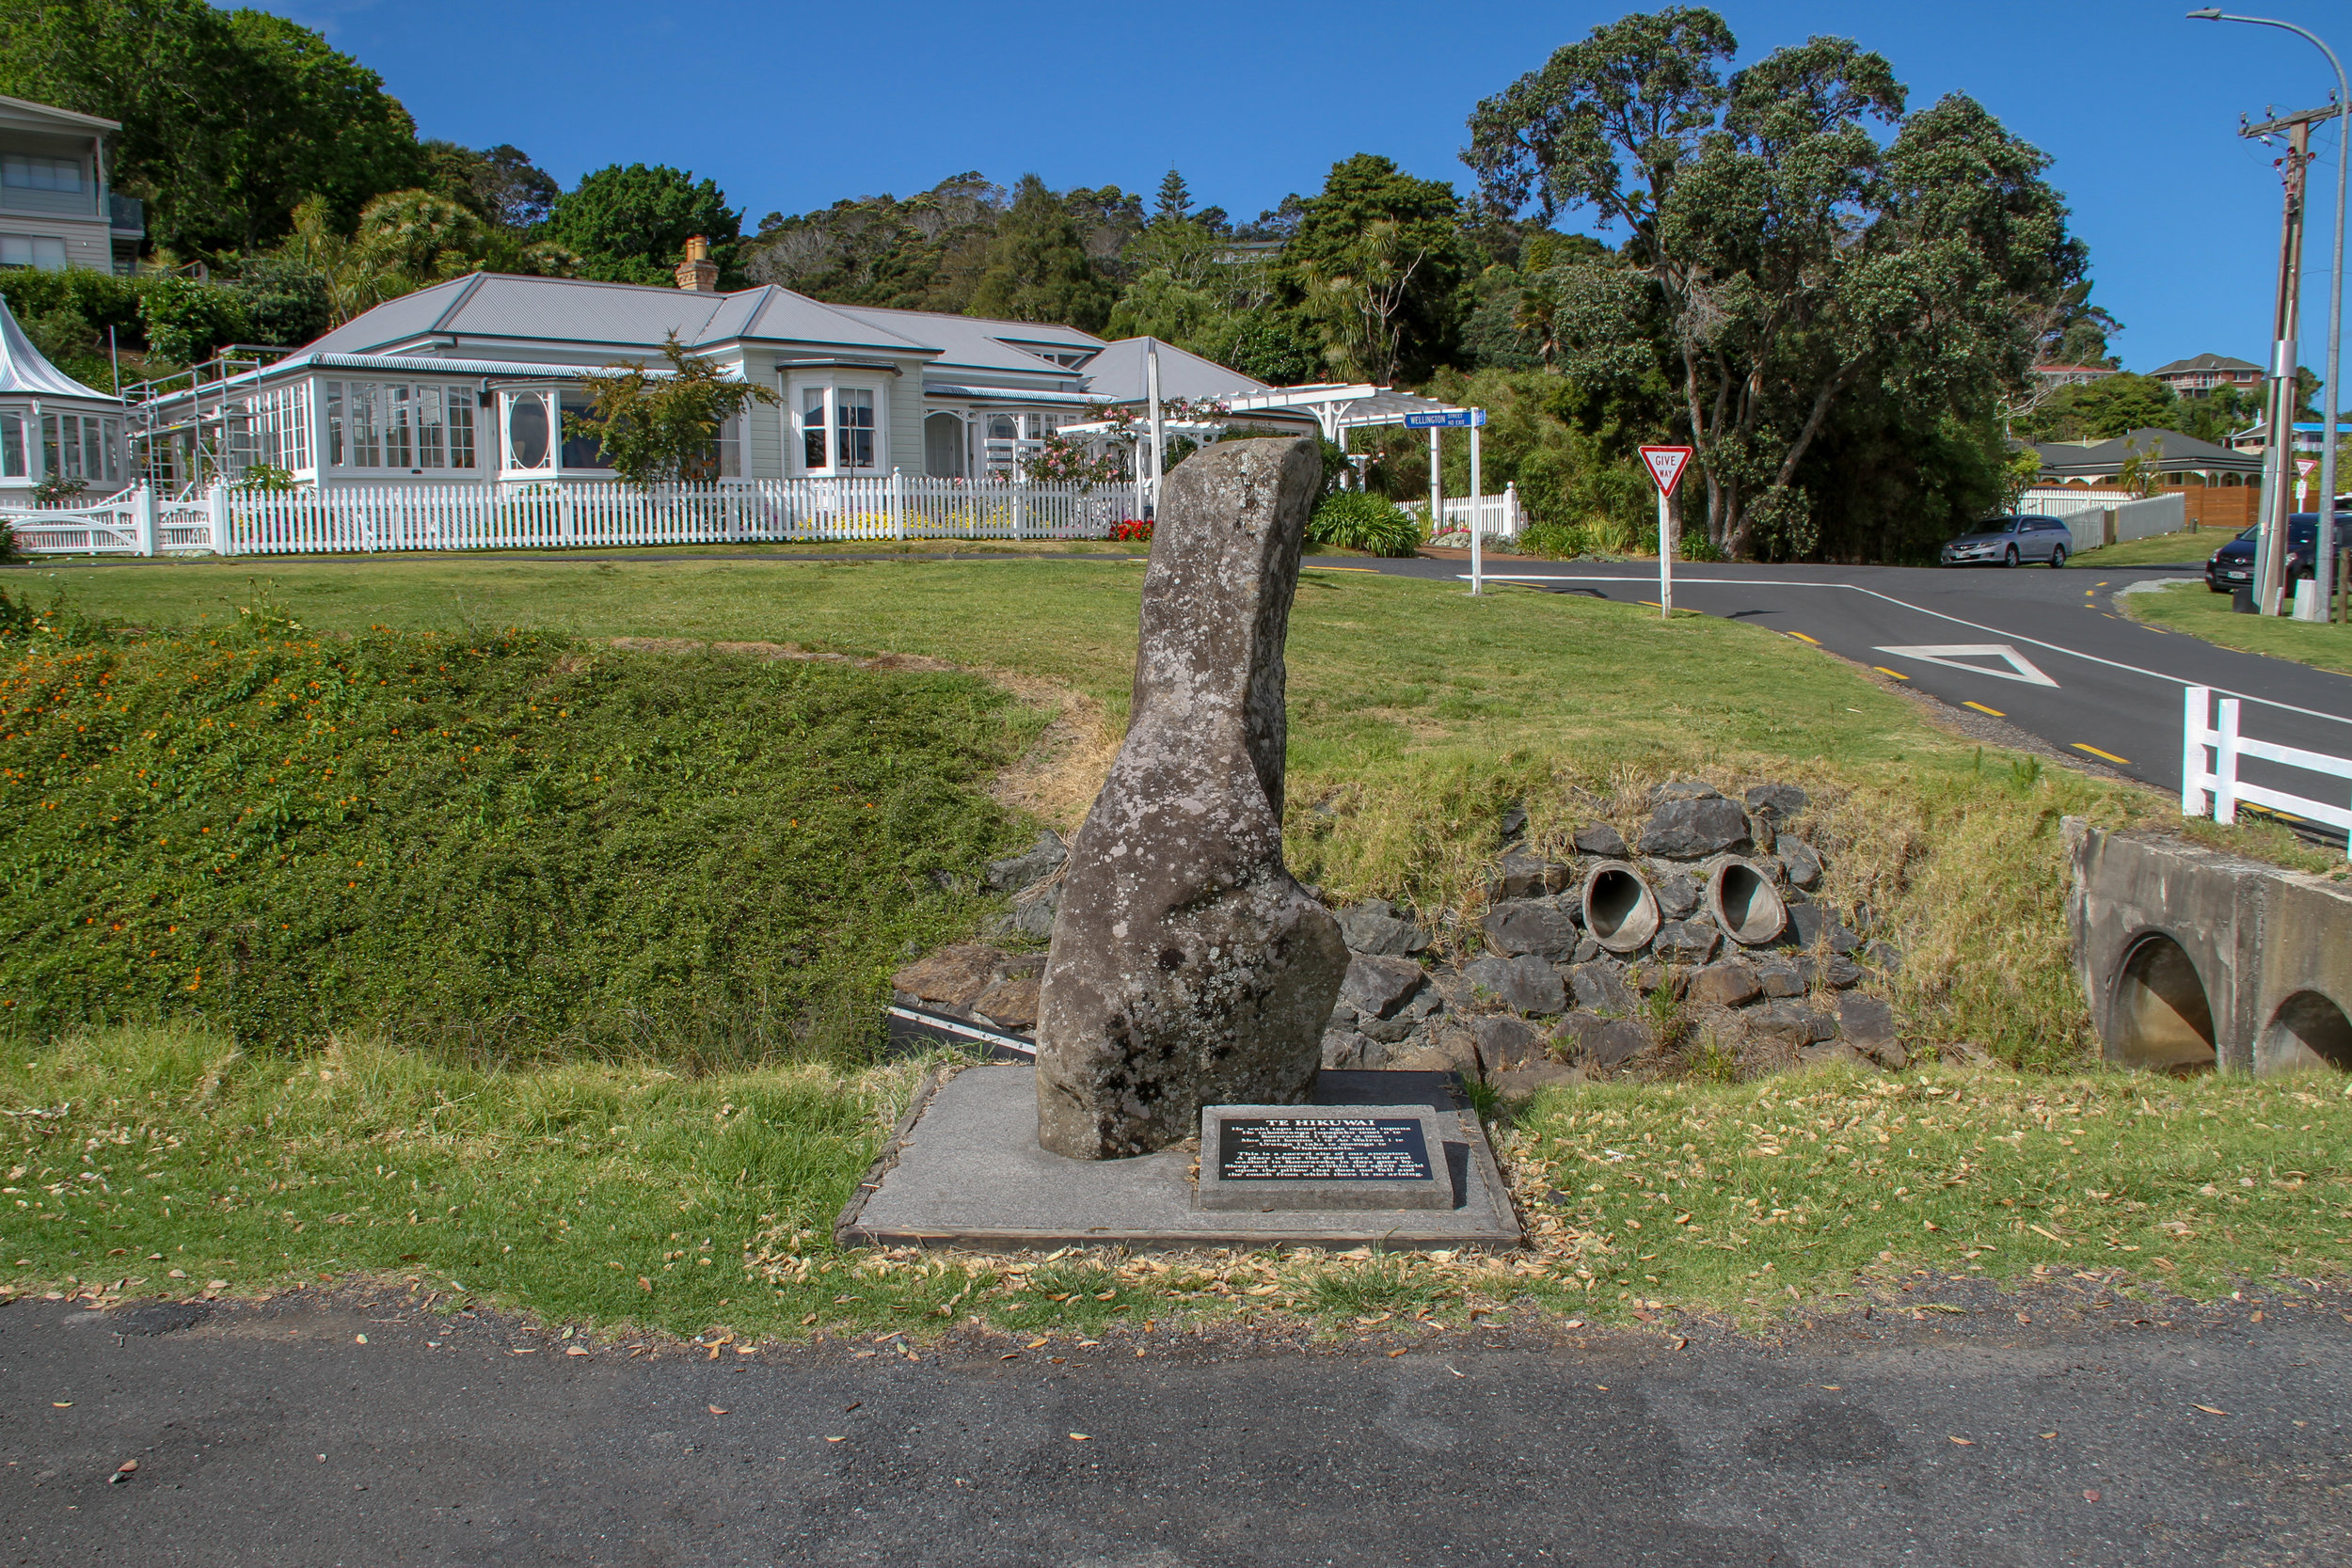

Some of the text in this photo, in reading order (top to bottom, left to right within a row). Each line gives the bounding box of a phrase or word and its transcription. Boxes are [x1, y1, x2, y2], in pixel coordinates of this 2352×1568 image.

[1409, 415, 1446, 424] WELLINGTON
[1655, 455, 1677, 466] GIVE
[1659, 469, 1674, 478] WAY
